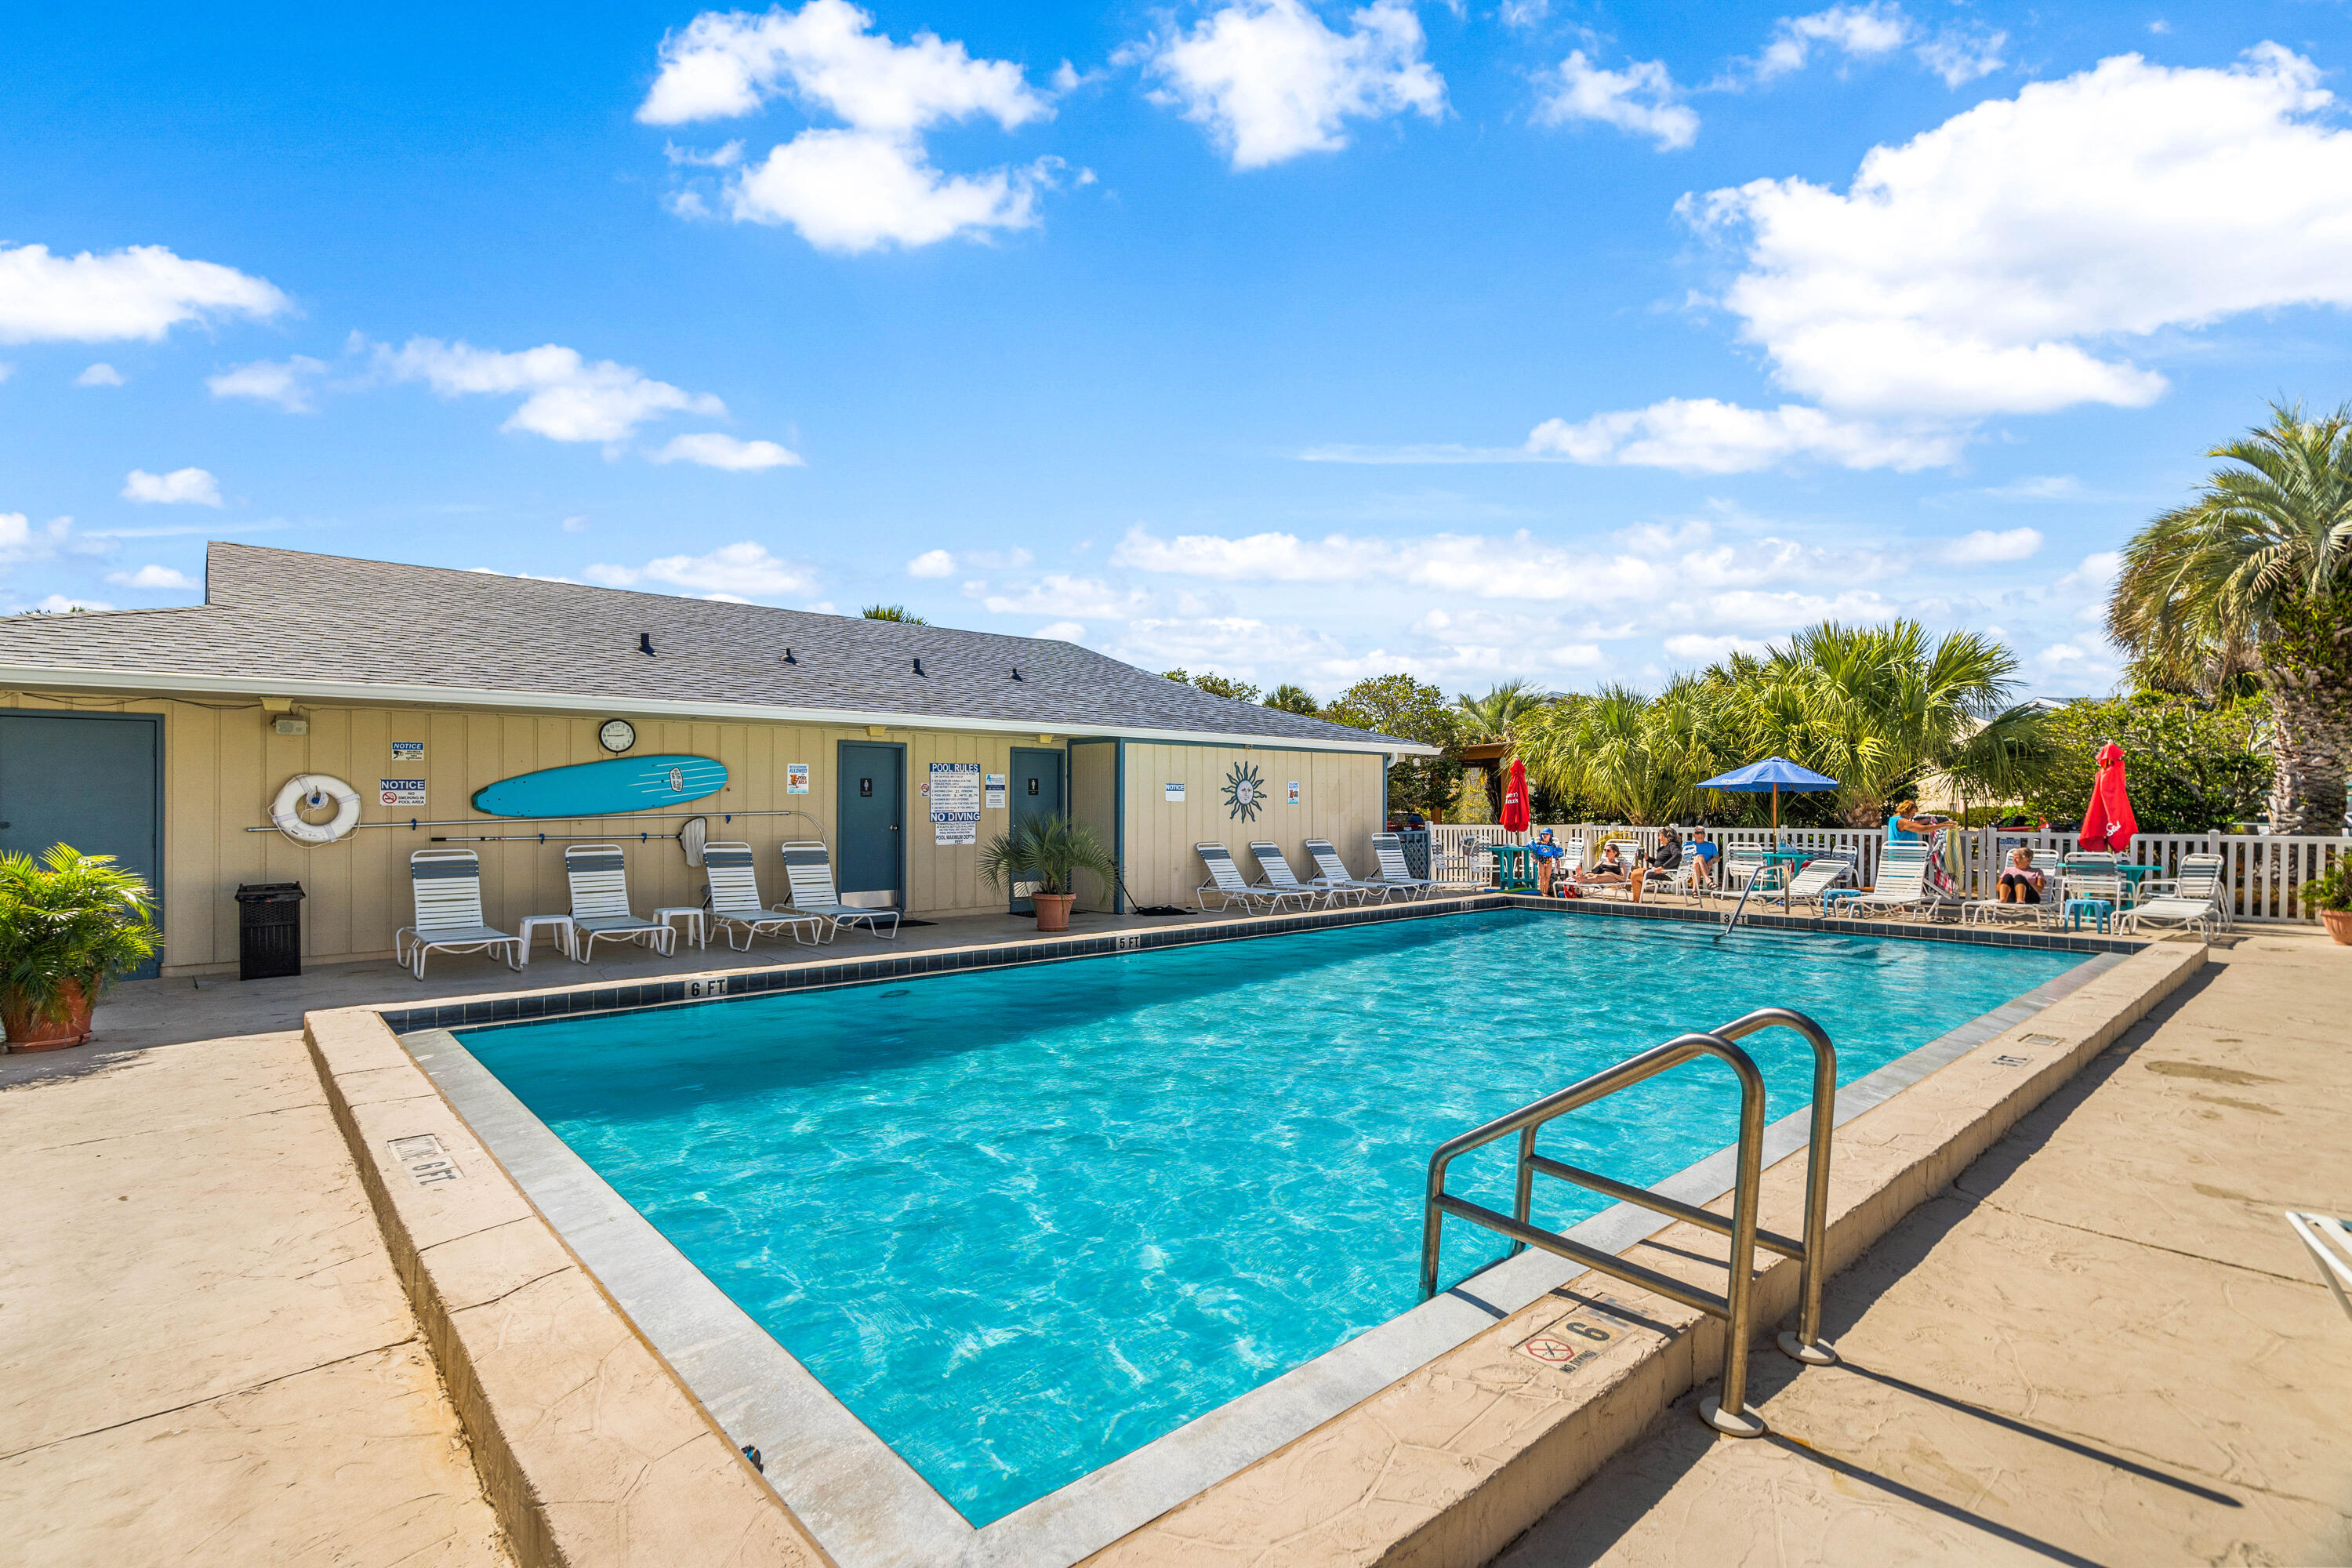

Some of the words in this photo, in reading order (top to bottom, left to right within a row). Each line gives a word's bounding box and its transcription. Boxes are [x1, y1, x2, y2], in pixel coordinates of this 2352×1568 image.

[933, 764, 953, 772] POOL
[955, 764, 978, 772] RULES
[381, 781, 424, 789] NOTICE
[931, 813, 945, 821] NO
[948, 812, 980, 821] DIVING
[1724, 914, 1730, 923] 3
[1120, 938, 1125, 949] 5
[691, 982, 700, 996] 6
[708, 979, 725, 995] FT.
[412, 1161, 446, 1171] 6
[1565, 1322, 1610, 1341] 6
[1559, 1363, 1577, 1374] NO
[1570, 1350, 1596, 1366] DIVING
